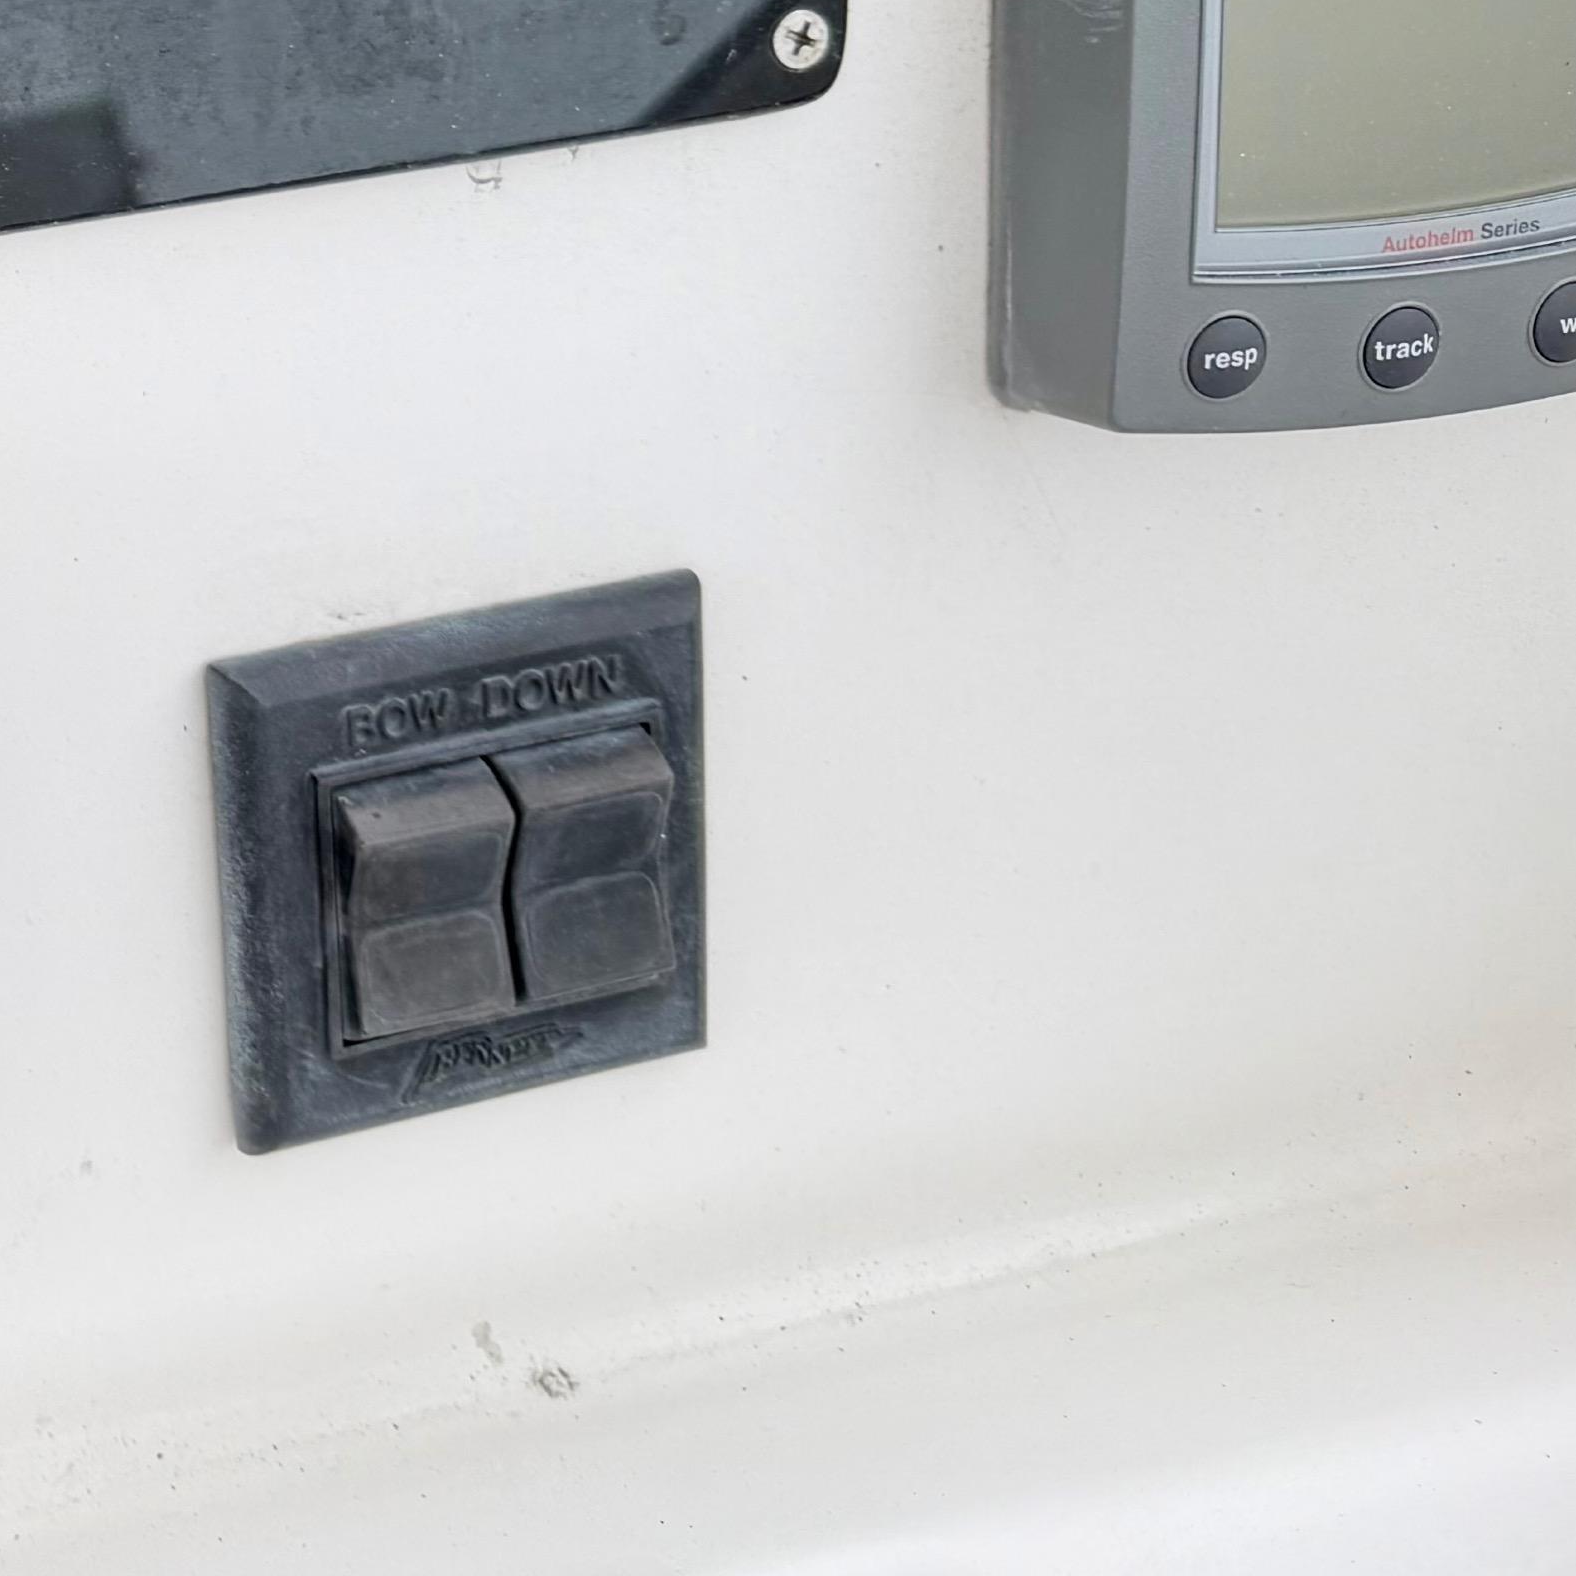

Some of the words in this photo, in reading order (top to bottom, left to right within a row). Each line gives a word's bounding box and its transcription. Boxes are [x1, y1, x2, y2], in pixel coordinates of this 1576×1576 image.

[1381, 228, 1475, 255] Autohelm
[1480, 218, 1541, 241] Series
[1560, 317, 1576, 334] w
[1203, 345, 1259, 371] resp
[1374, 333, 1435, 362] track
[342, 688, 448, 750] BOW
[479, 654, 623, 719] DOWN
